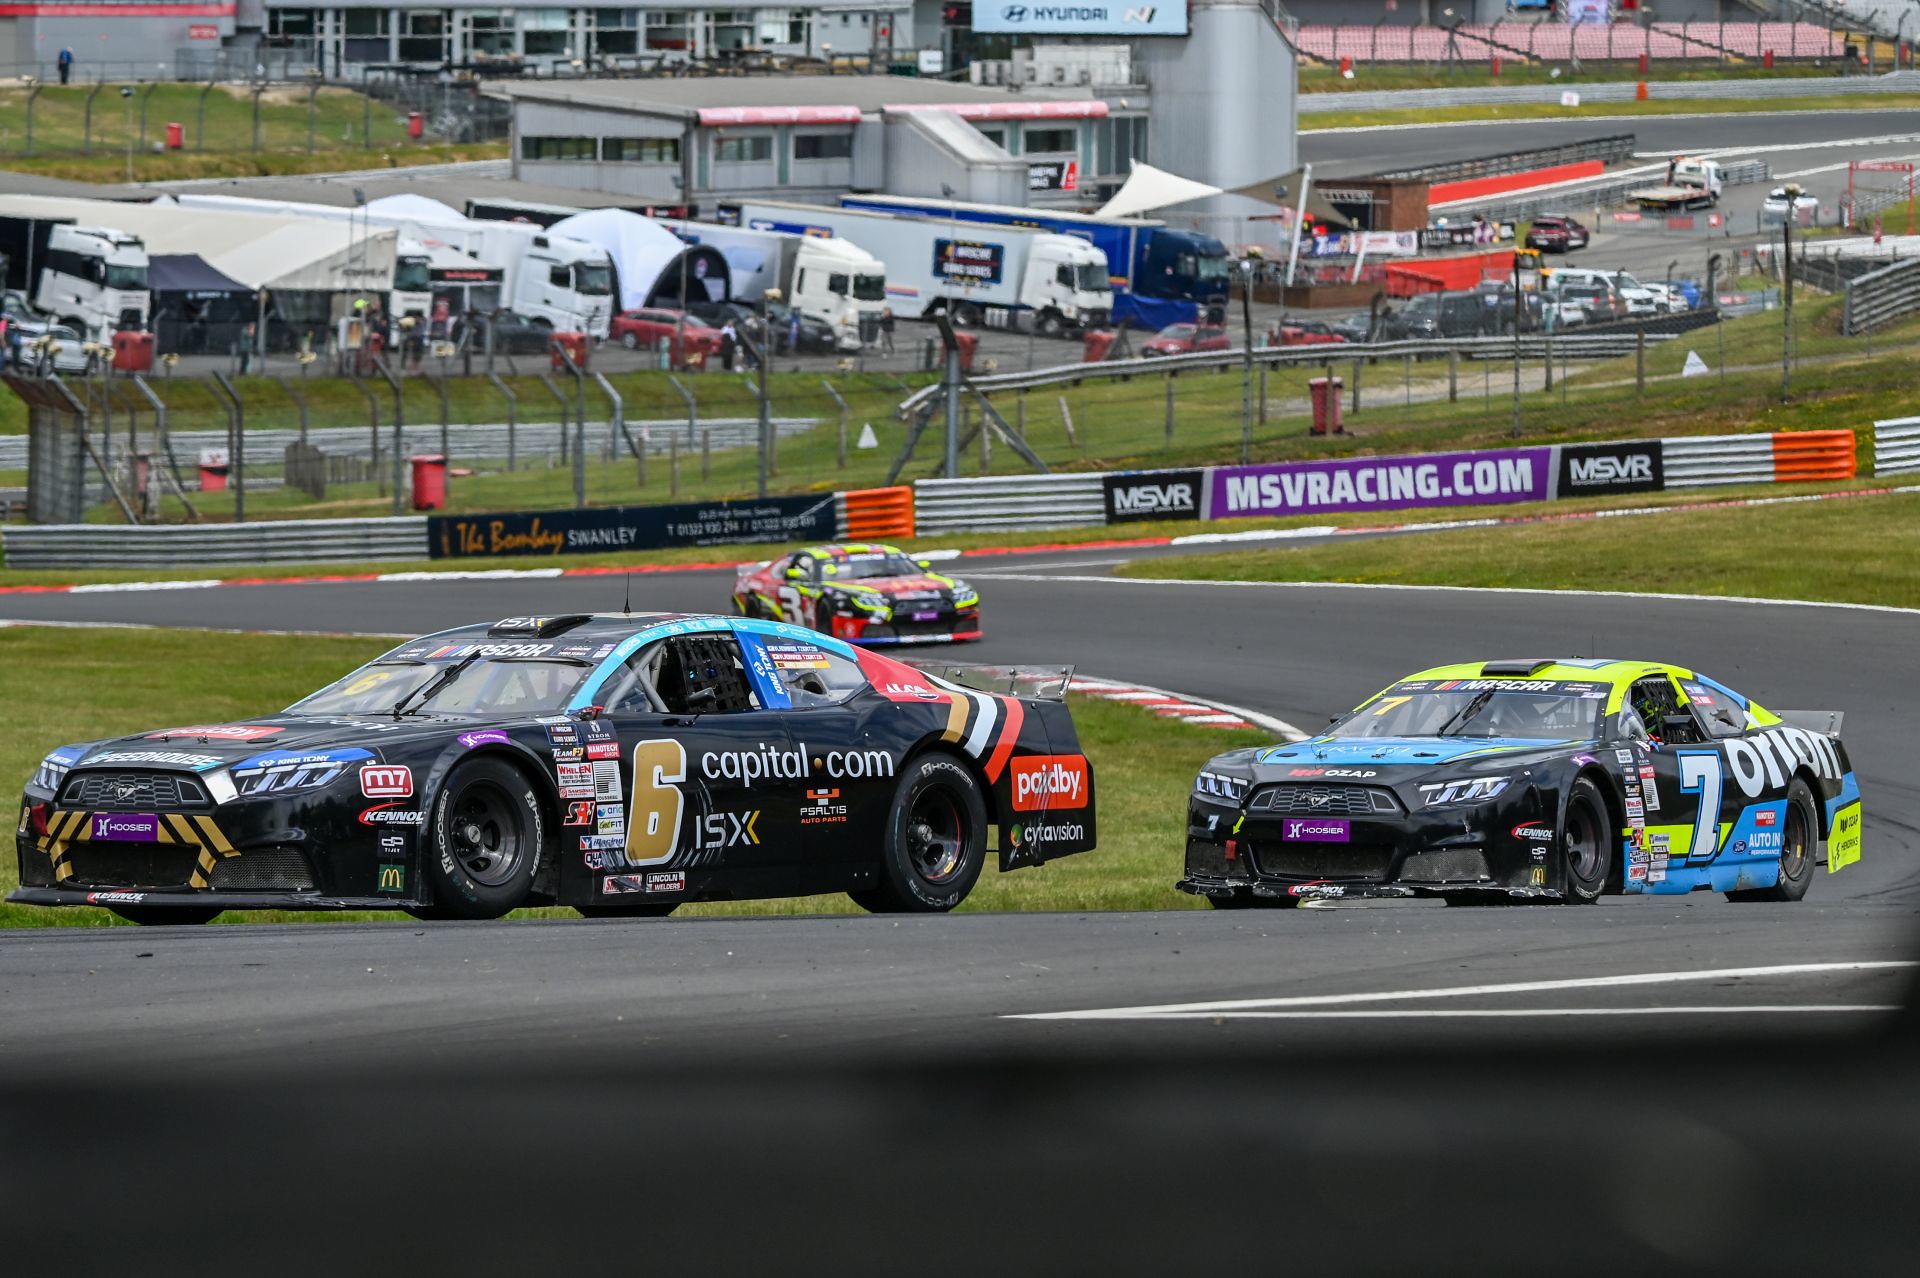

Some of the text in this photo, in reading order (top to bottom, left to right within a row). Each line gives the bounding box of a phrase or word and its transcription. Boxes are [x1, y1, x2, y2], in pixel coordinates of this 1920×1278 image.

[1034, 8, 1107, 20] HYUNDAI
[1569, 454, 1652, 480] MSVR
[1226, 458, 1532, 511] MSVRACING.COM
[1113, 483, 1194, 509] MSVR
[457, 517, 638, 555] The Bombay SWANLEY
[452, 644, 554, 658] NASCAR
[344, 672, 391, 696] 6
[1461, 680, 1557, 692] NASCAR
[1373, 696, 1414, 716] 7
[587, 744, 618, 753] NANOTECH
[278, 755, 331, 765] KING TONY
[1723, 727, 1842, 798] orion
[558, 764, 592, 775] WHELEN
[1324, 769, 1377, 778] OZAP
[625, 739, 687, 866] 6
[1679, 752, 1721, 860] 7
[364, 810, 425, 822] KENNOL
[800, 805, 847, 816] PSALTIS
[109, 823, 152, 832] HOOSIER
[696, 810, 760, 849] ISX
[1208, 814, 1220, 831] 7
[1024, 822, 1084, 848] cytavision
[1302, 827, 1344, 835] HOOSIER
[1515, 827, 1553, 838] KENNOL
[1748, 832, 1781, 848] AUTO IN
[648, 874, 678, 883] LINCOLN
[655, 882, 681, 891] WELDERS
